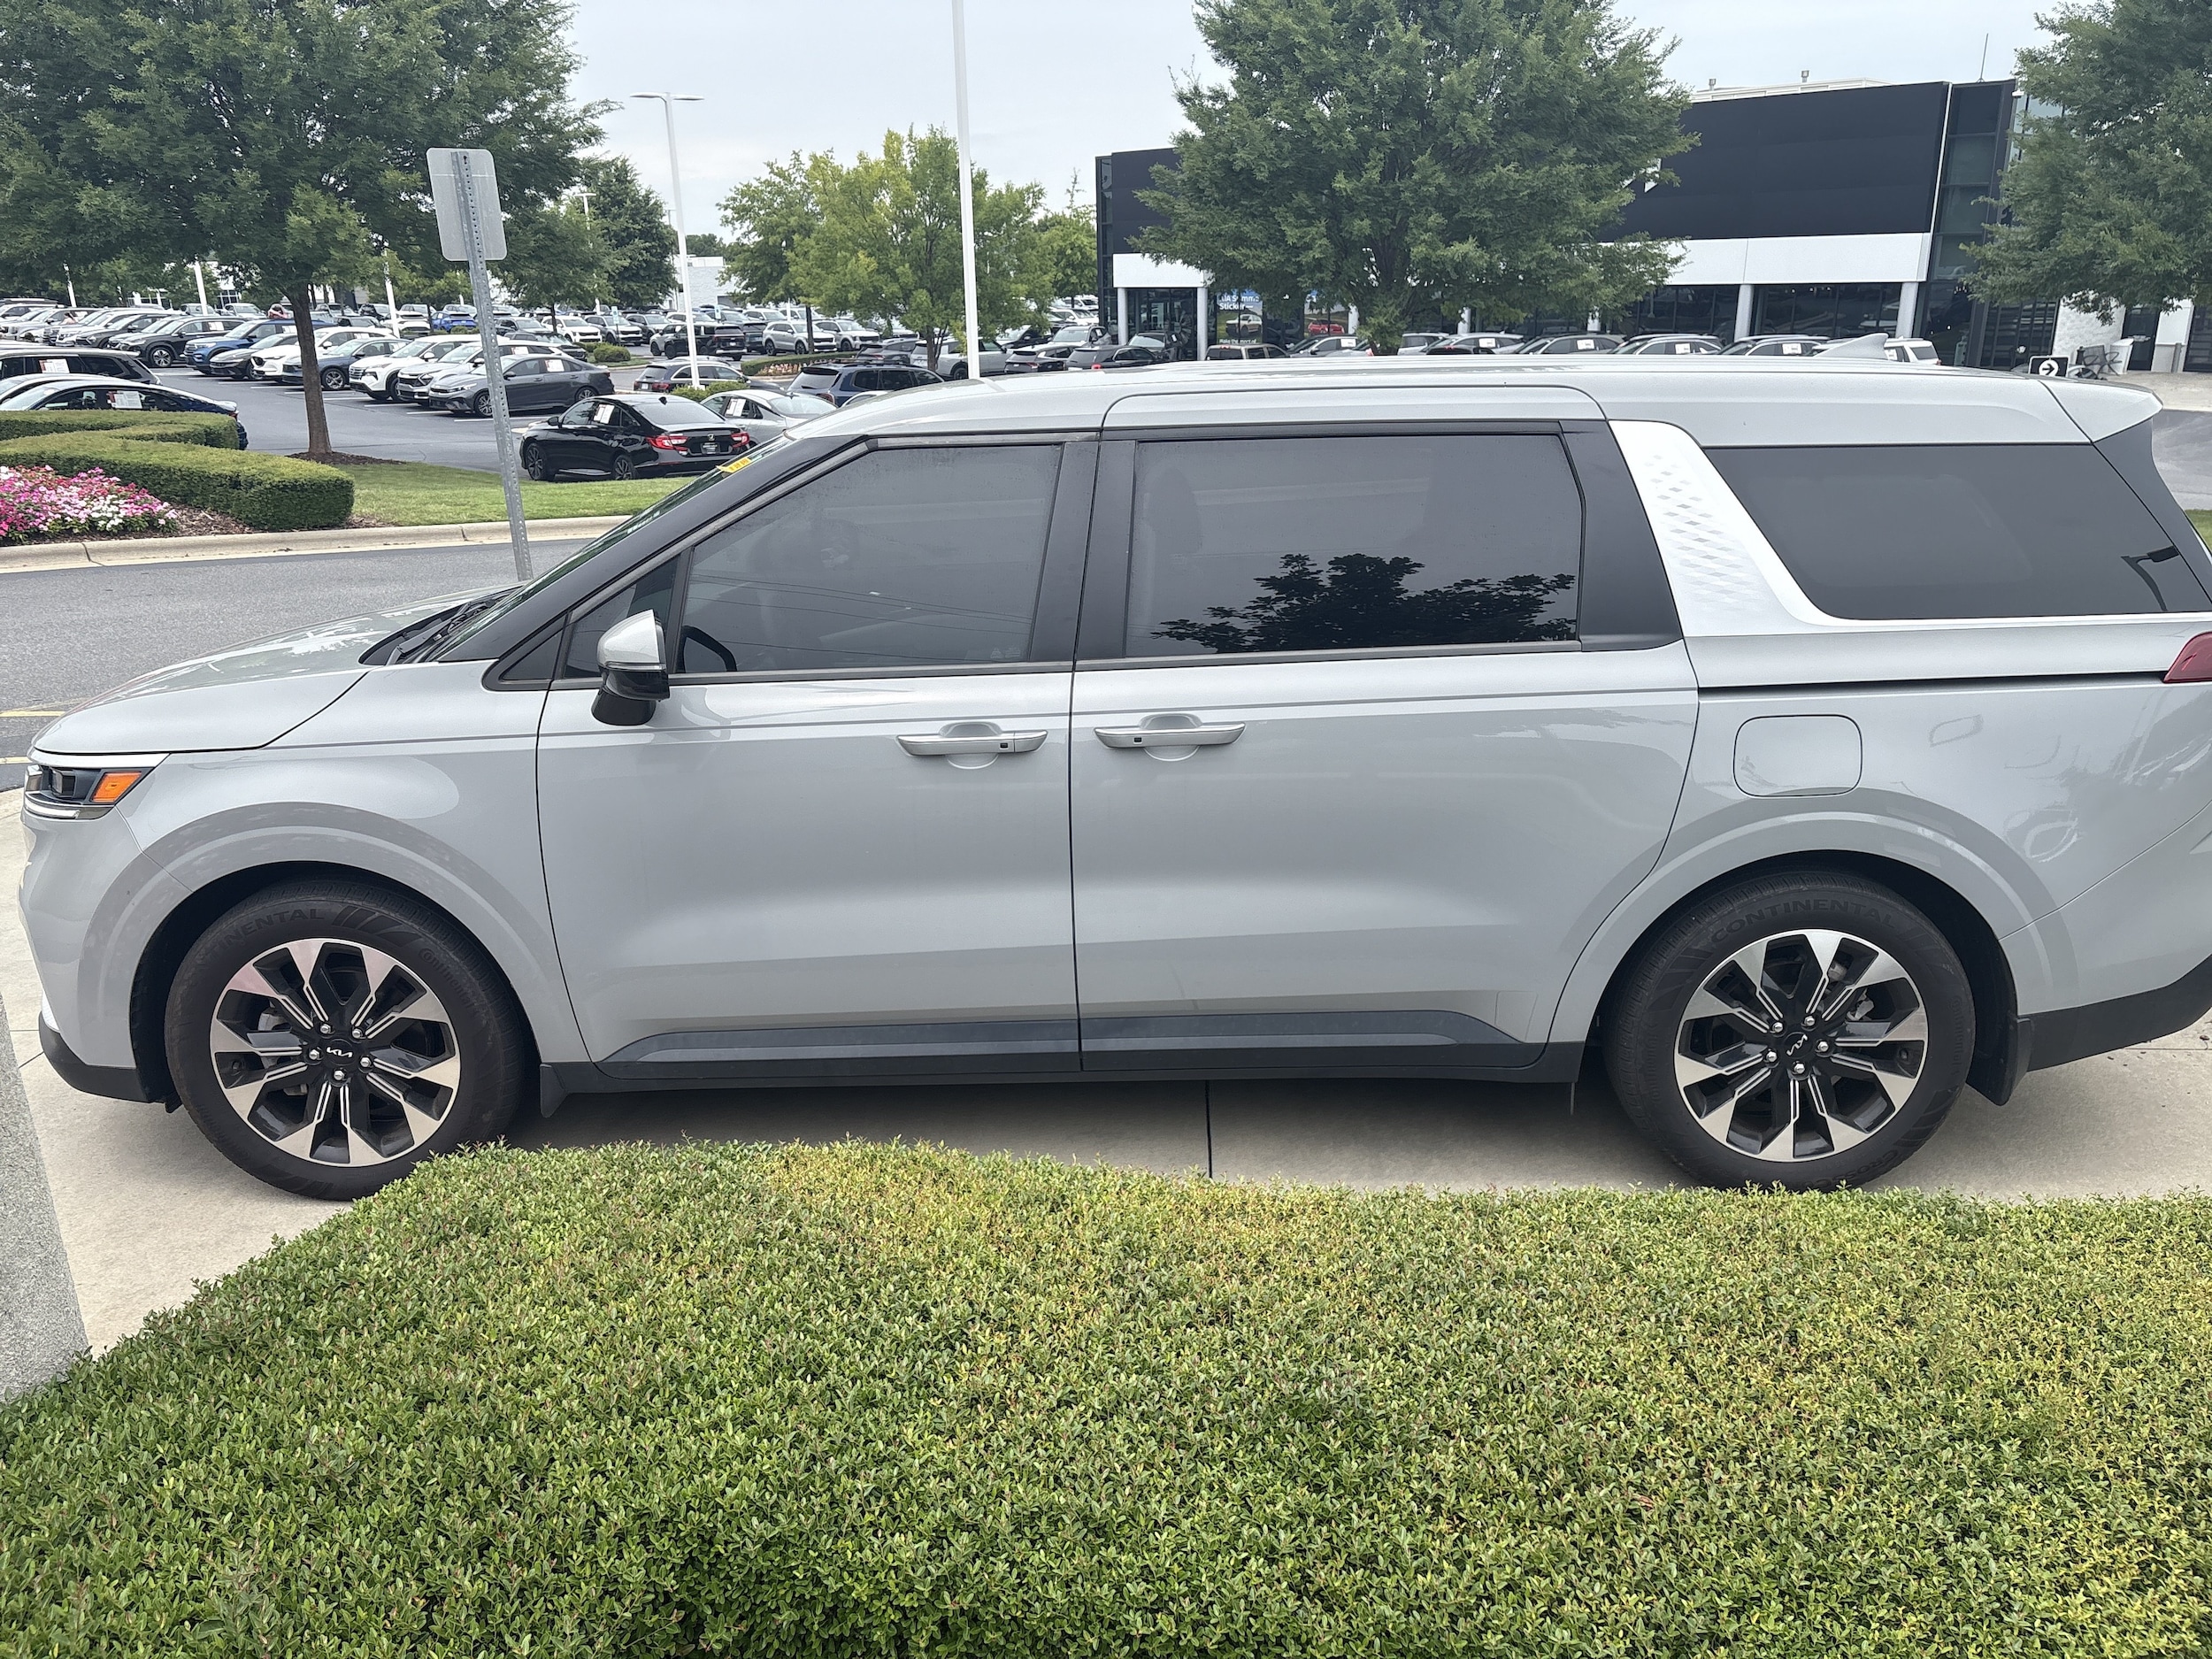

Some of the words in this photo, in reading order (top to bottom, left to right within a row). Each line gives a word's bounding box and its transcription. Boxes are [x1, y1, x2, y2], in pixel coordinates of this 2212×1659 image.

[202, 908, 325, 963] TINENTAL
[1710, 898, 1897, 944] CONTINENTAL
[326, 1047, 353, 1058] KIA
[1786, 1034, 1809, 1056] KIA
